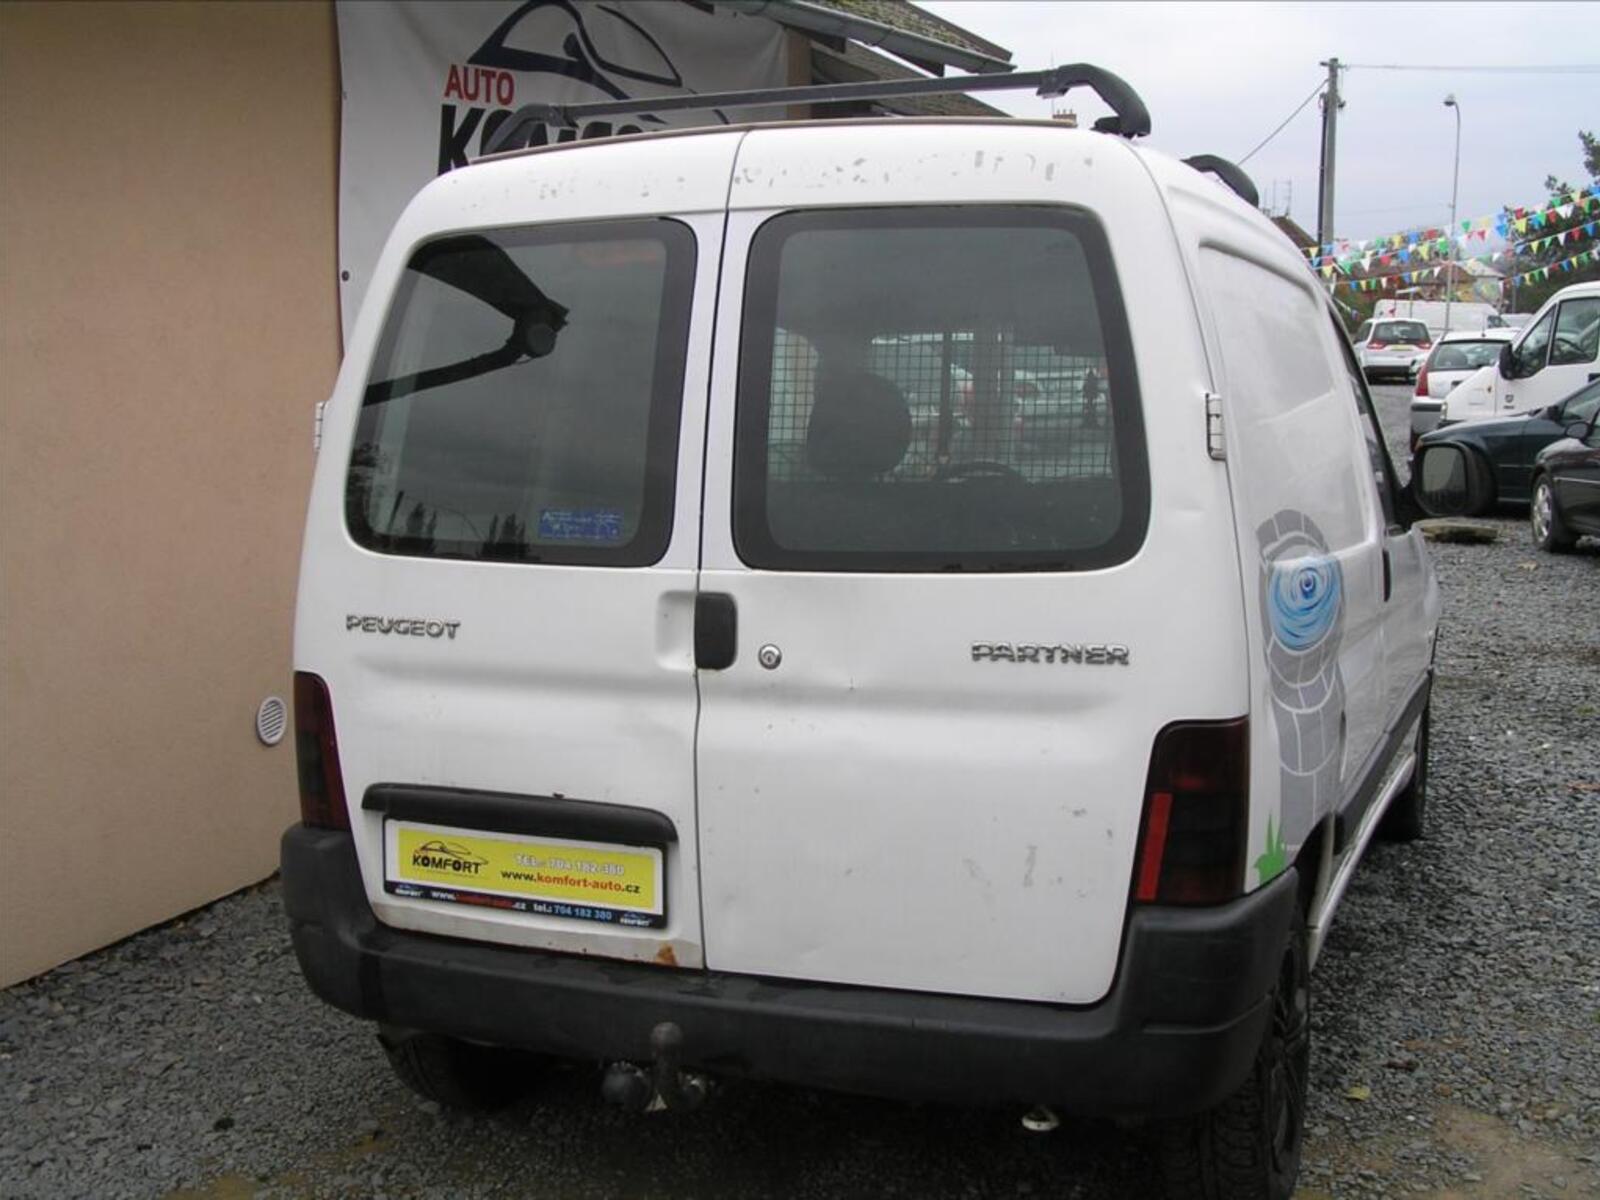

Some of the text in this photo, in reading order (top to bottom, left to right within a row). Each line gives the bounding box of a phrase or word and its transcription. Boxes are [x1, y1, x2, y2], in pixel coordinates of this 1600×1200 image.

[445, 64, 515, 106] AUTO
[346, 614, 461, 640] PEUGEOT
[971, 641, 1130, 666] PARTNER
[412, 853, 481, 875] KOMFORT
[500, 869, 641, 894] www.komfort-auto.cz
